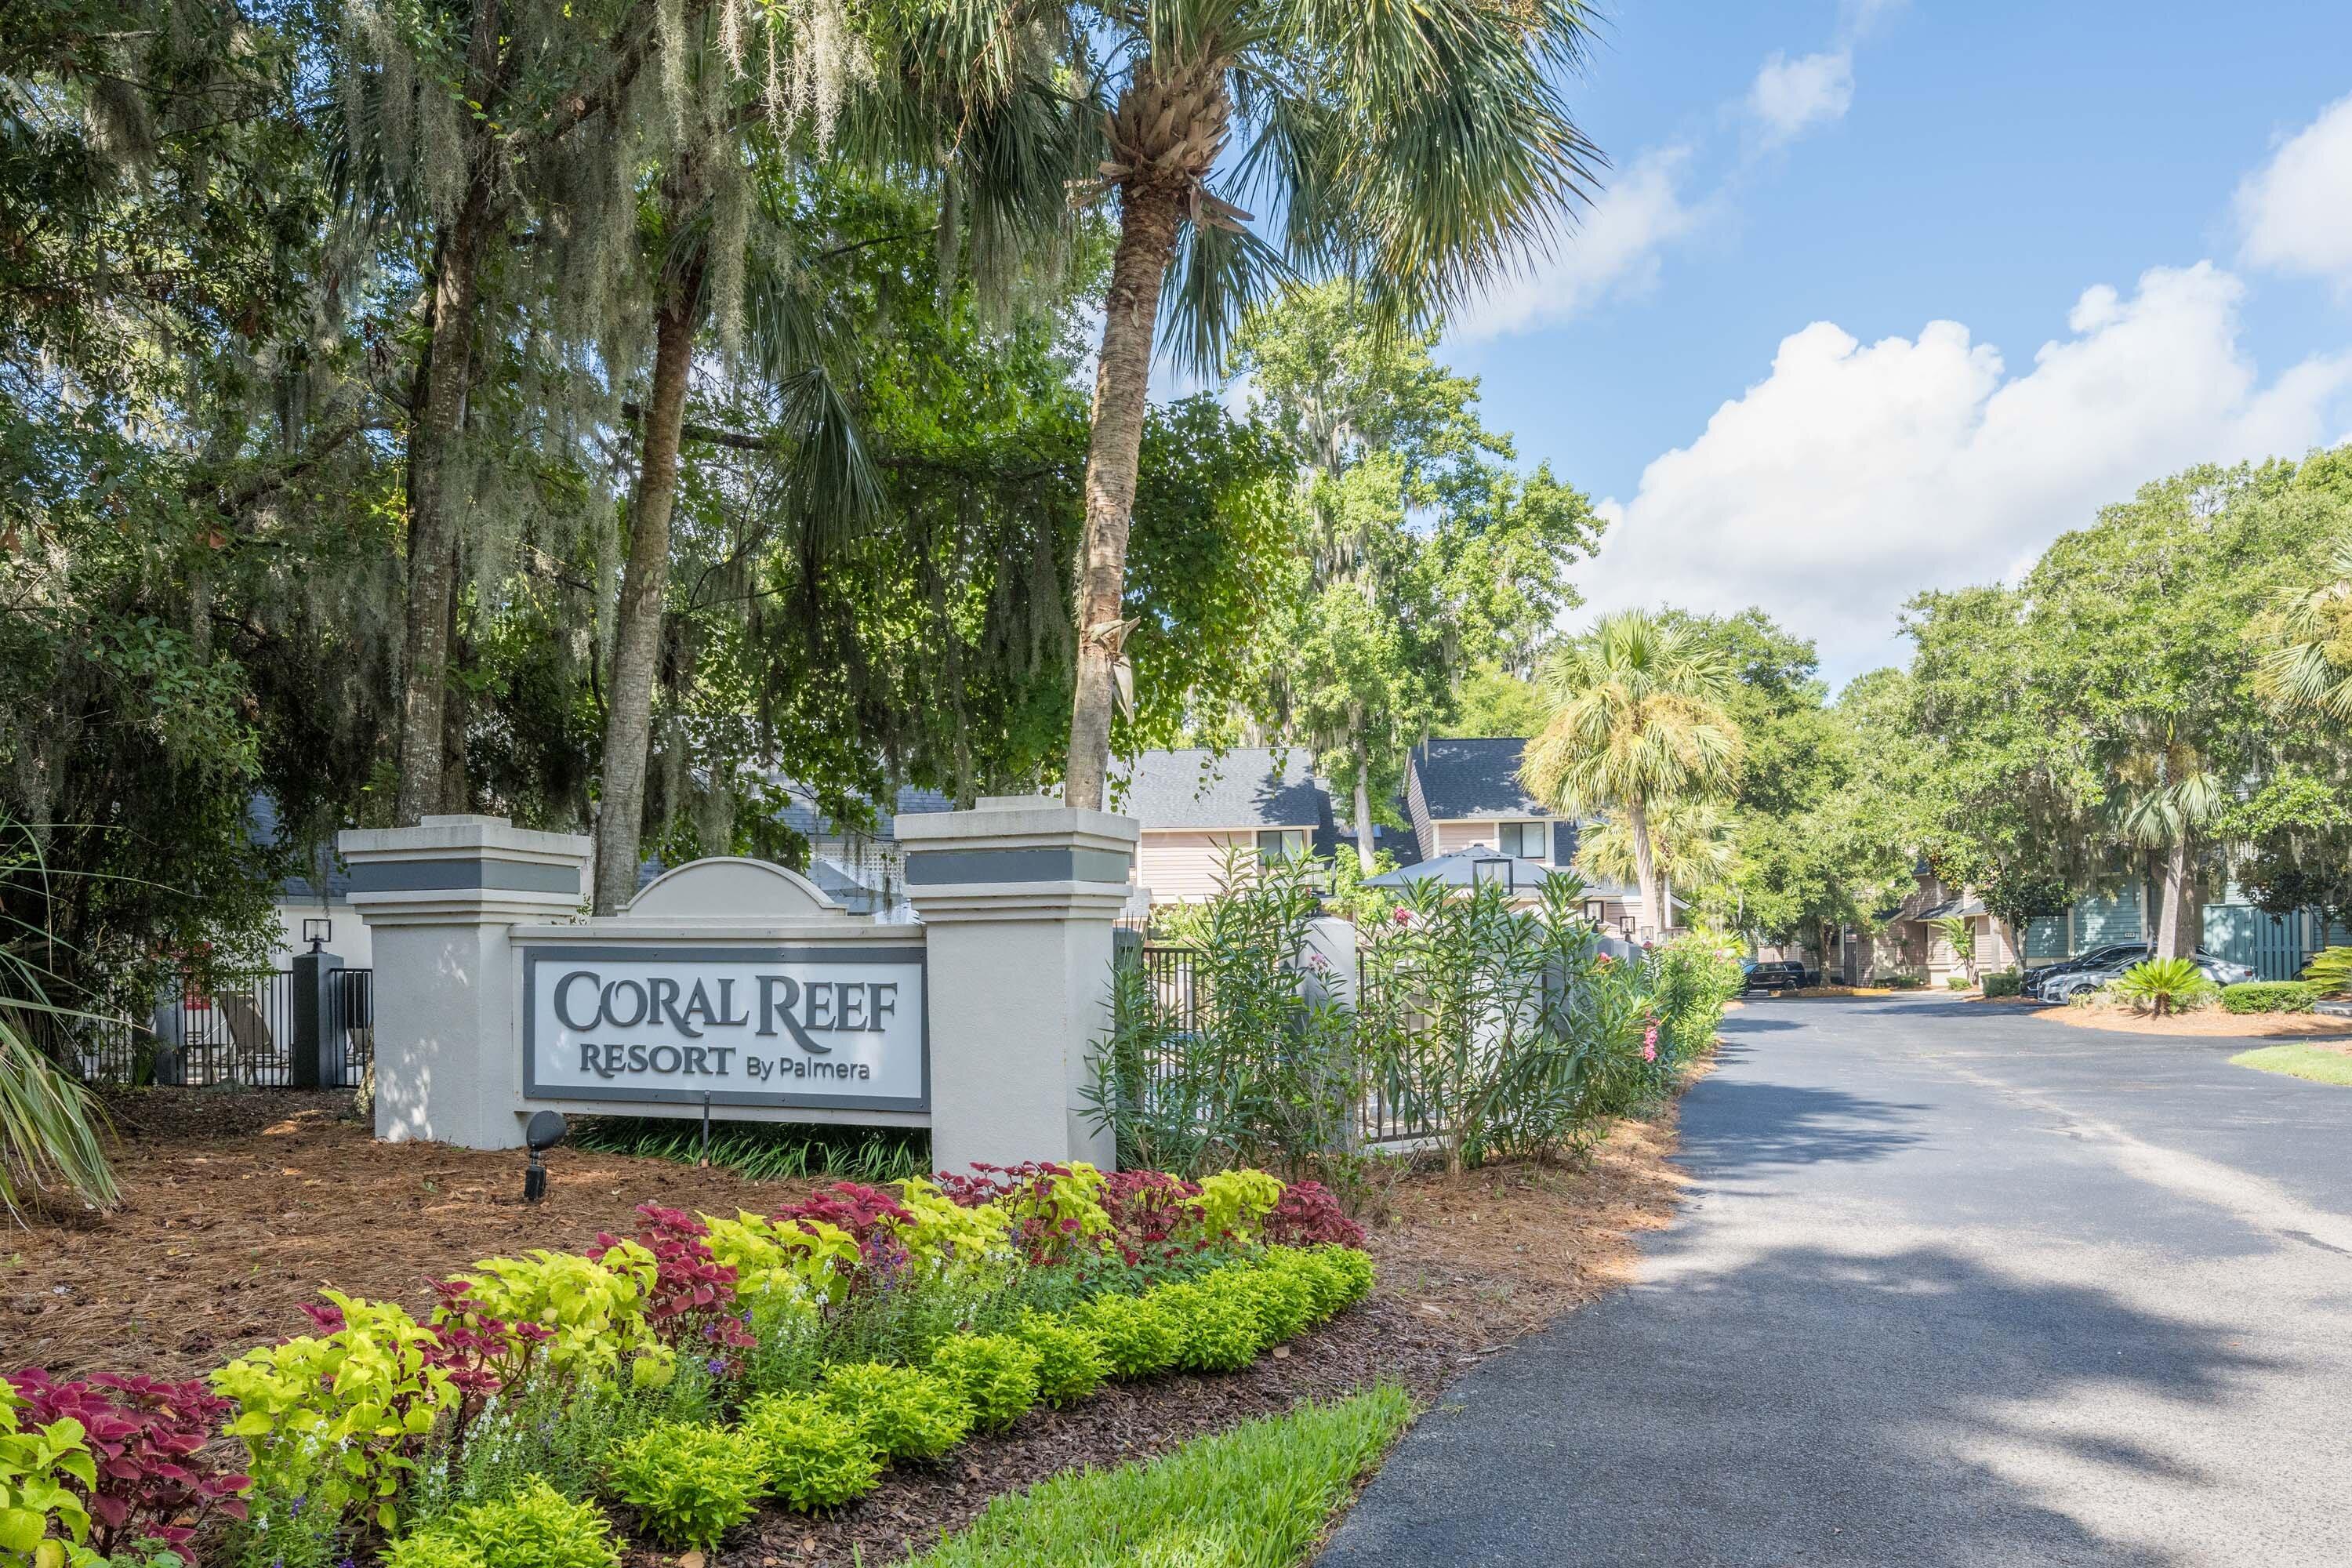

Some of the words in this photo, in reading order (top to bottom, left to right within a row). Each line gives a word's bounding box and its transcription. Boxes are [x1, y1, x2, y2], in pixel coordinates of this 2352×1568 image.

[554, 971, 750, 1039] CORAL
[755, 975, 898, 1055] REEF
[579, 1044, 736, 1080] RESORT
[746, 1056, 774, 1081] By
[779, 1056, 870, 1080] Palmera
